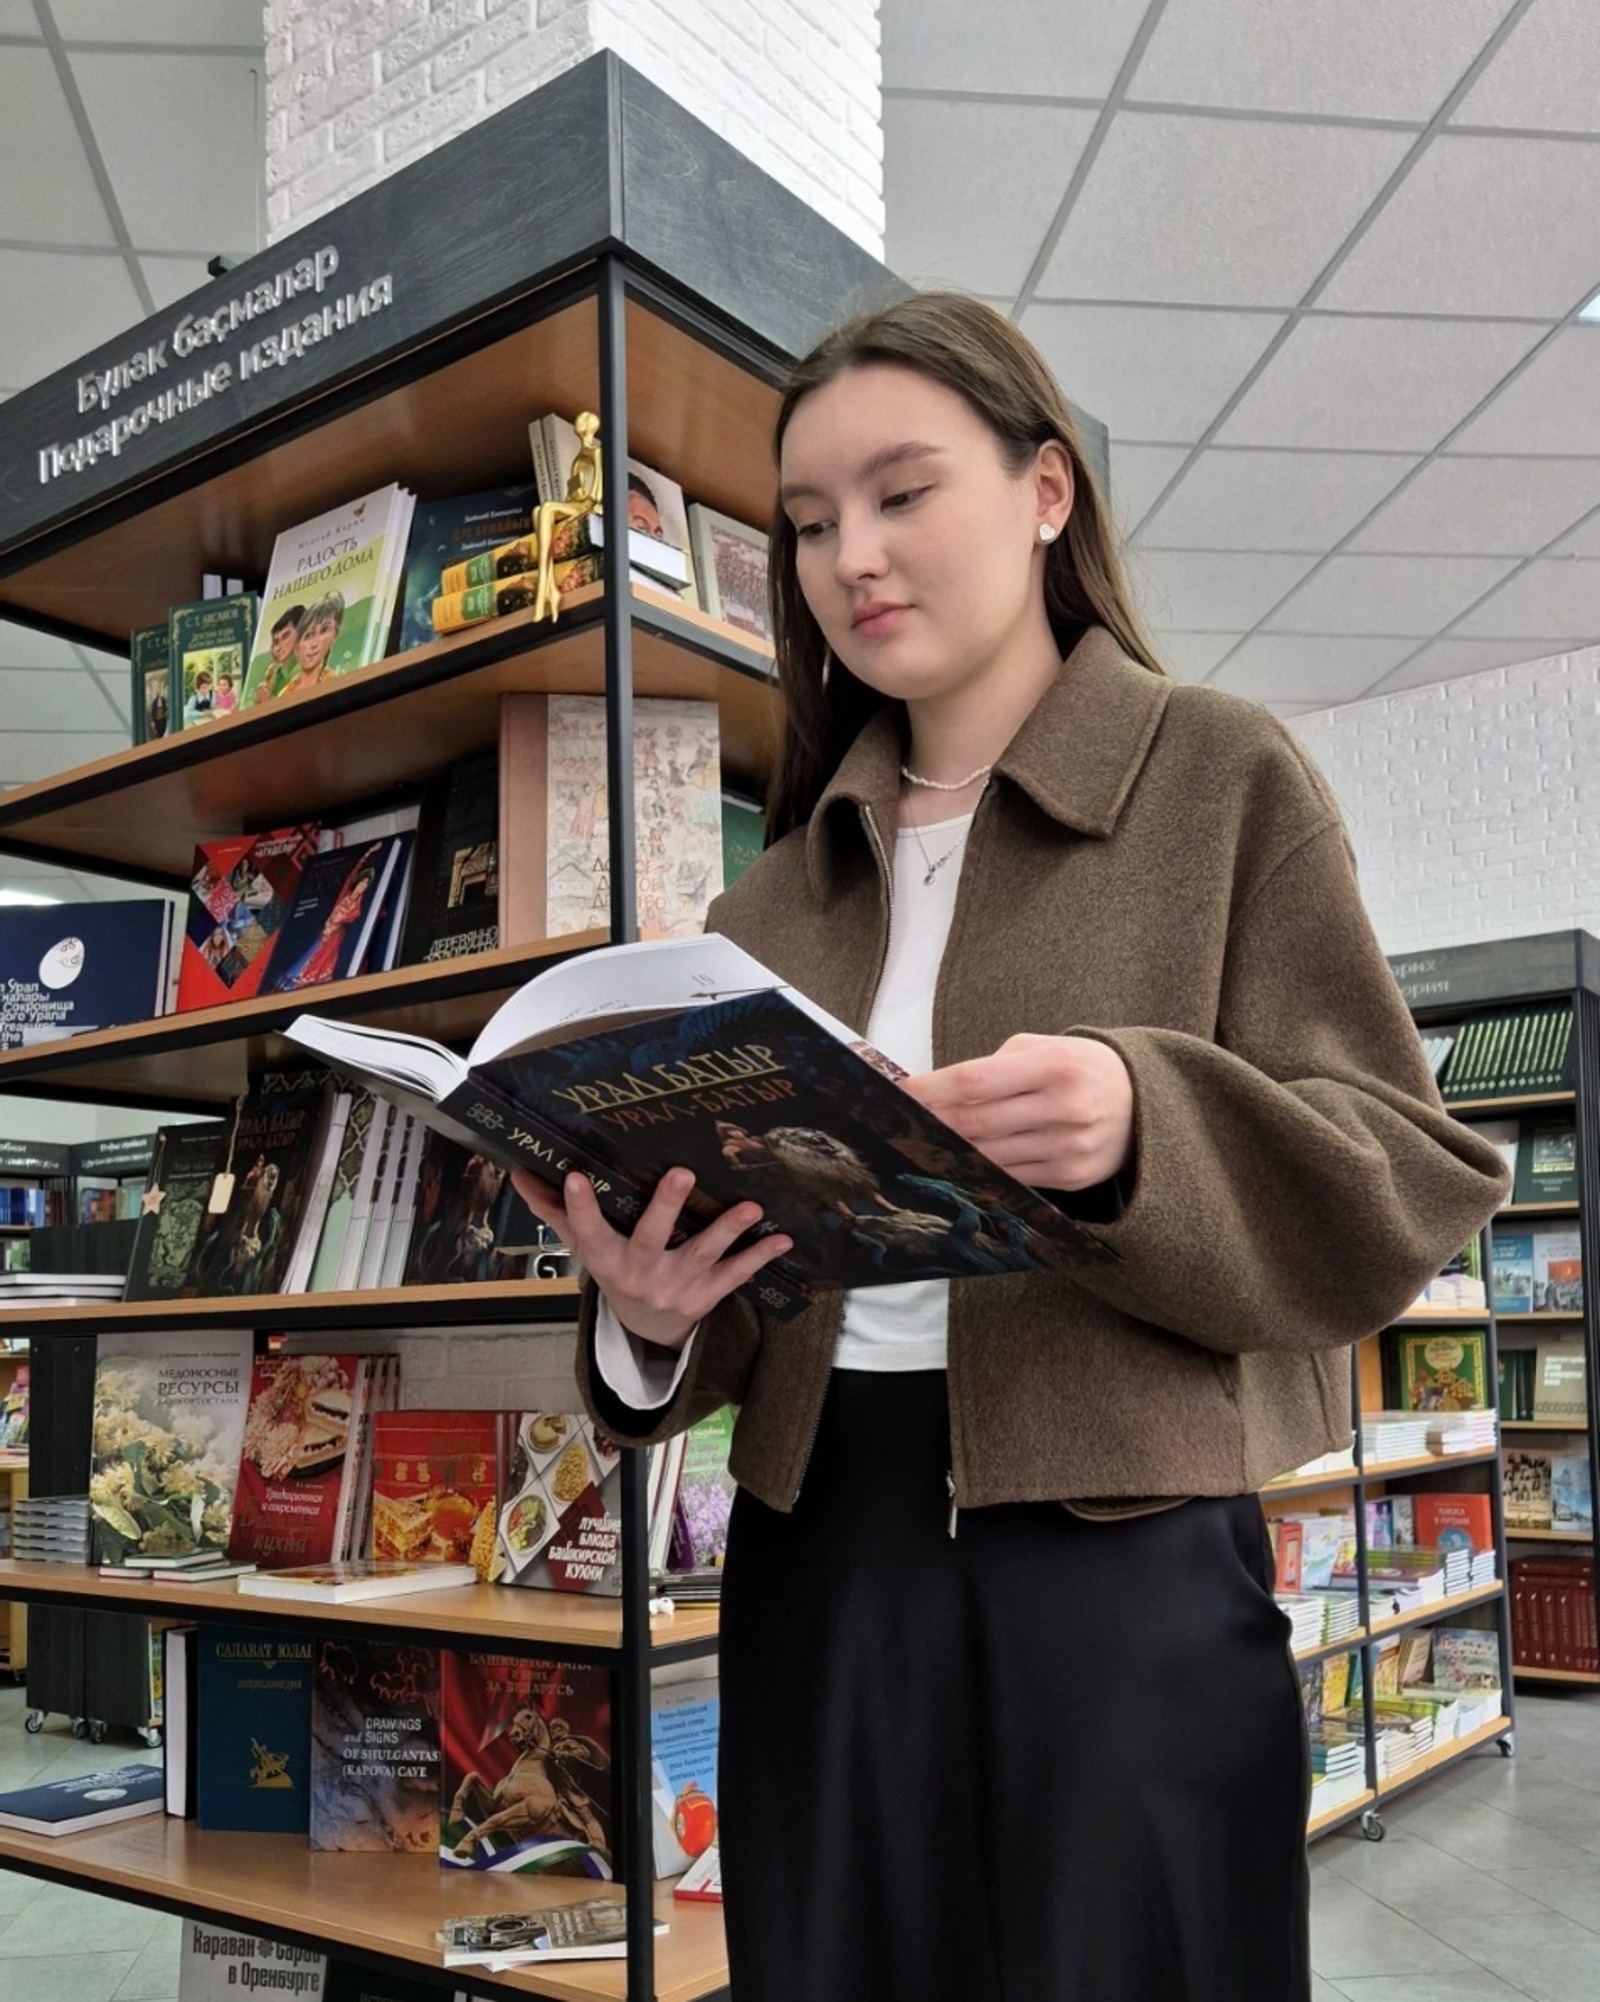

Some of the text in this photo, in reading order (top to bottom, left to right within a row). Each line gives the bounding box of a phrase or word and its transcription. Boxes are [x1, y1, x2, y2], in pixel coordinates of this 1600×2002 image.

[38, 273, 393, 484] Подарочные издания
[296, 536, 358, 573] РАДОСТЬ
[273, 548, 374, 600] НАШЕГО ДОМА
[552, 1043, 774, 1114] УРАЛ БАТЫР
[599, 1078, 798, 1132] УРАЛ-БАТЫР
[506, 1126, 612, 1195] УРАЛ БЫР
[158, 1367, 240, 1379] МЕДОНОСНЫЕ
[157, 1380, 240, 1396] РЕСУРСЫ
[216, 1643, 312, 1659] САЛАВАТ ЮЛА
[486, 1681, 502, 1692] ЗА
[366, 1717, 422, 1731] DRAWINGS
[343, 1731, 398, 1744] and SIGNS
[342, 1748, 360, 1760] OF
[342, 1764, 428, 1779] (KAPOVA) CAVE
[193, 1925, 255, 1961] Караван
[228, 1961, 320, 1997] в Оренбурге
